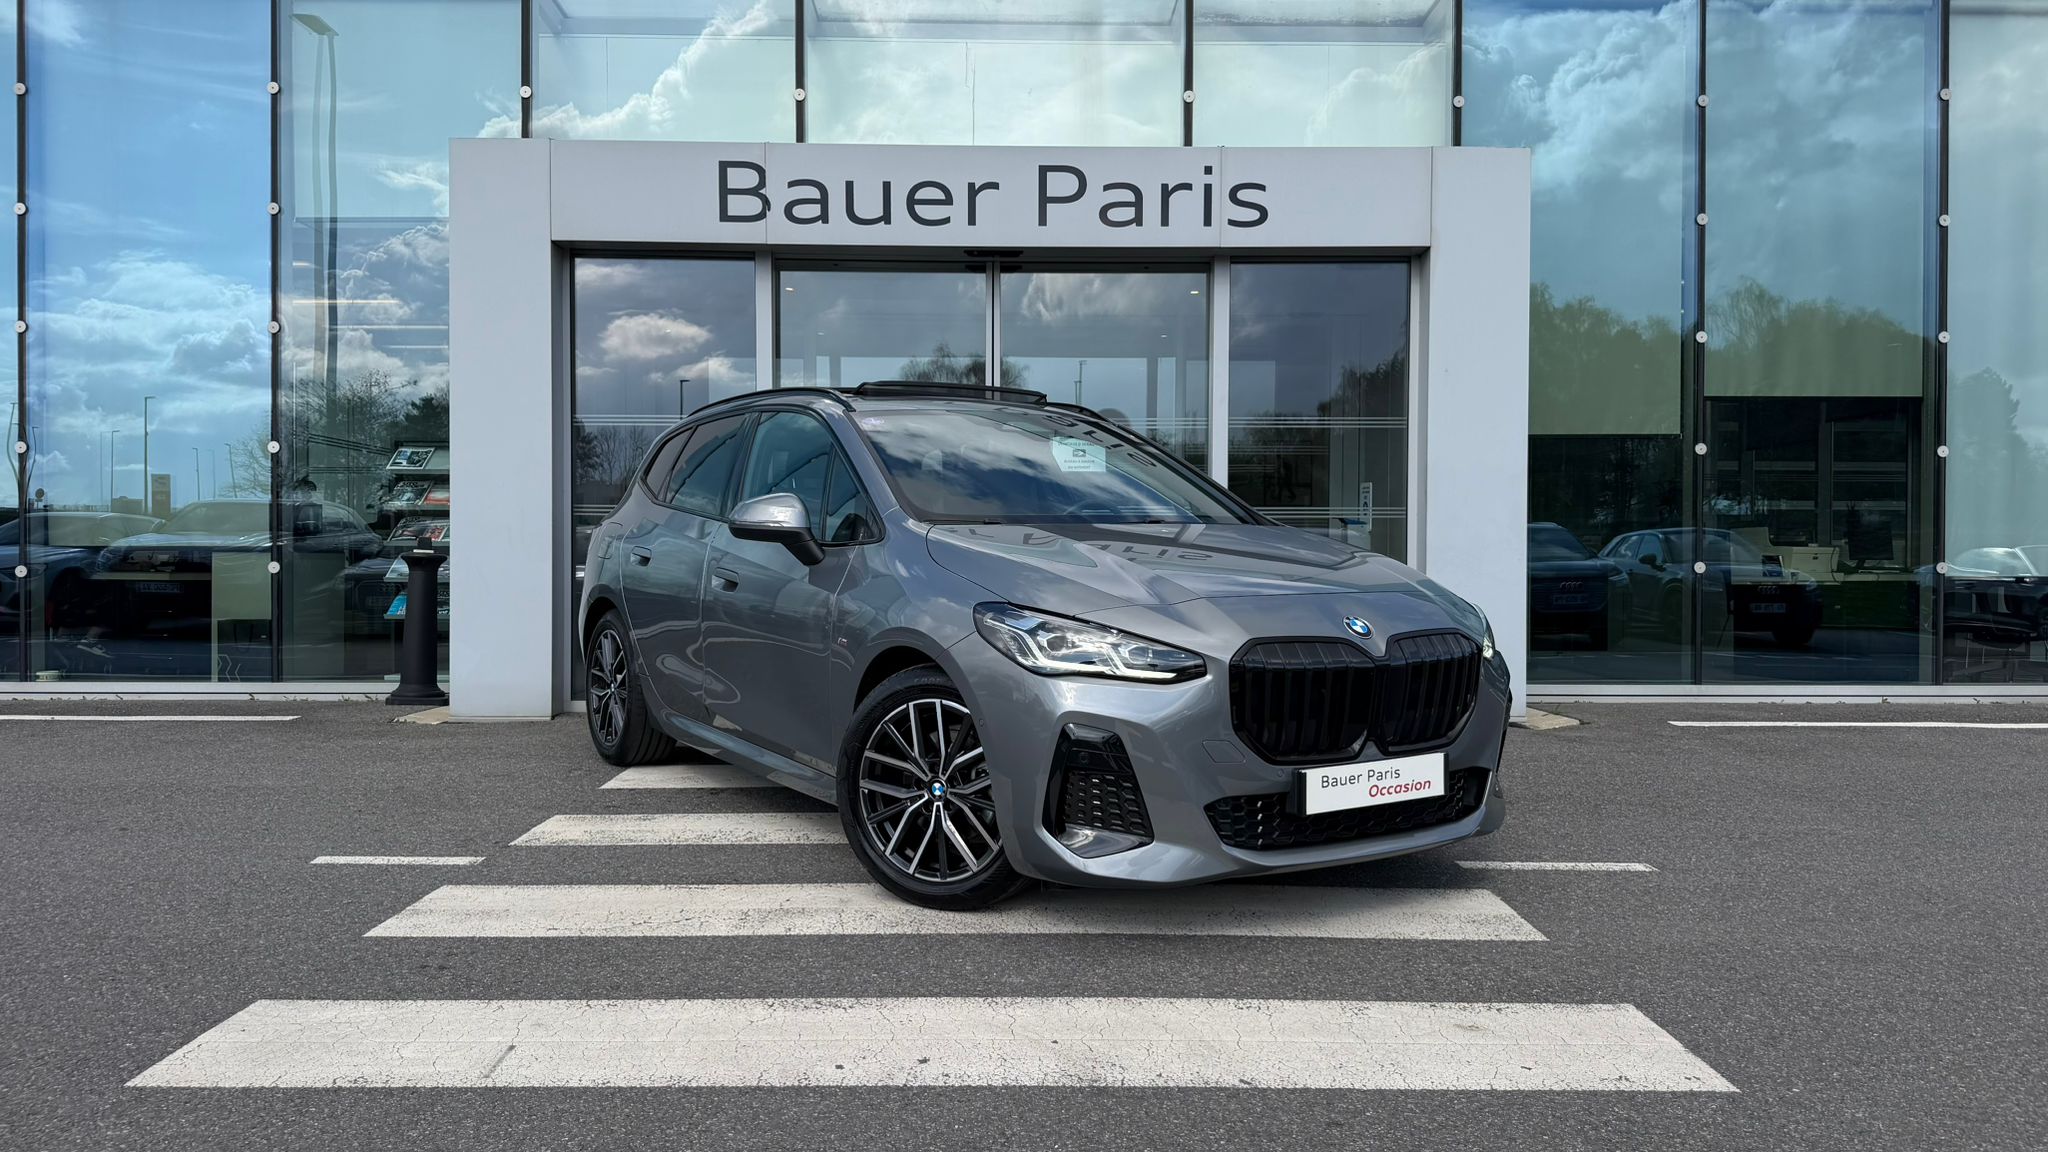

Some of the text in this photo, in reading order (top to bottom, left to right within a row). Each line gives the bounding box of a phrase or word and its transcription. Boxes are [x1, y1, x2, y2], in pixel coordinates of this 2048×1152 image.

[718, 160, 1269, 228] Bauer Paris
[1321, 767, 1401, 788] Bauer Paris
[1368, 779, 1431, 798] Occasion
